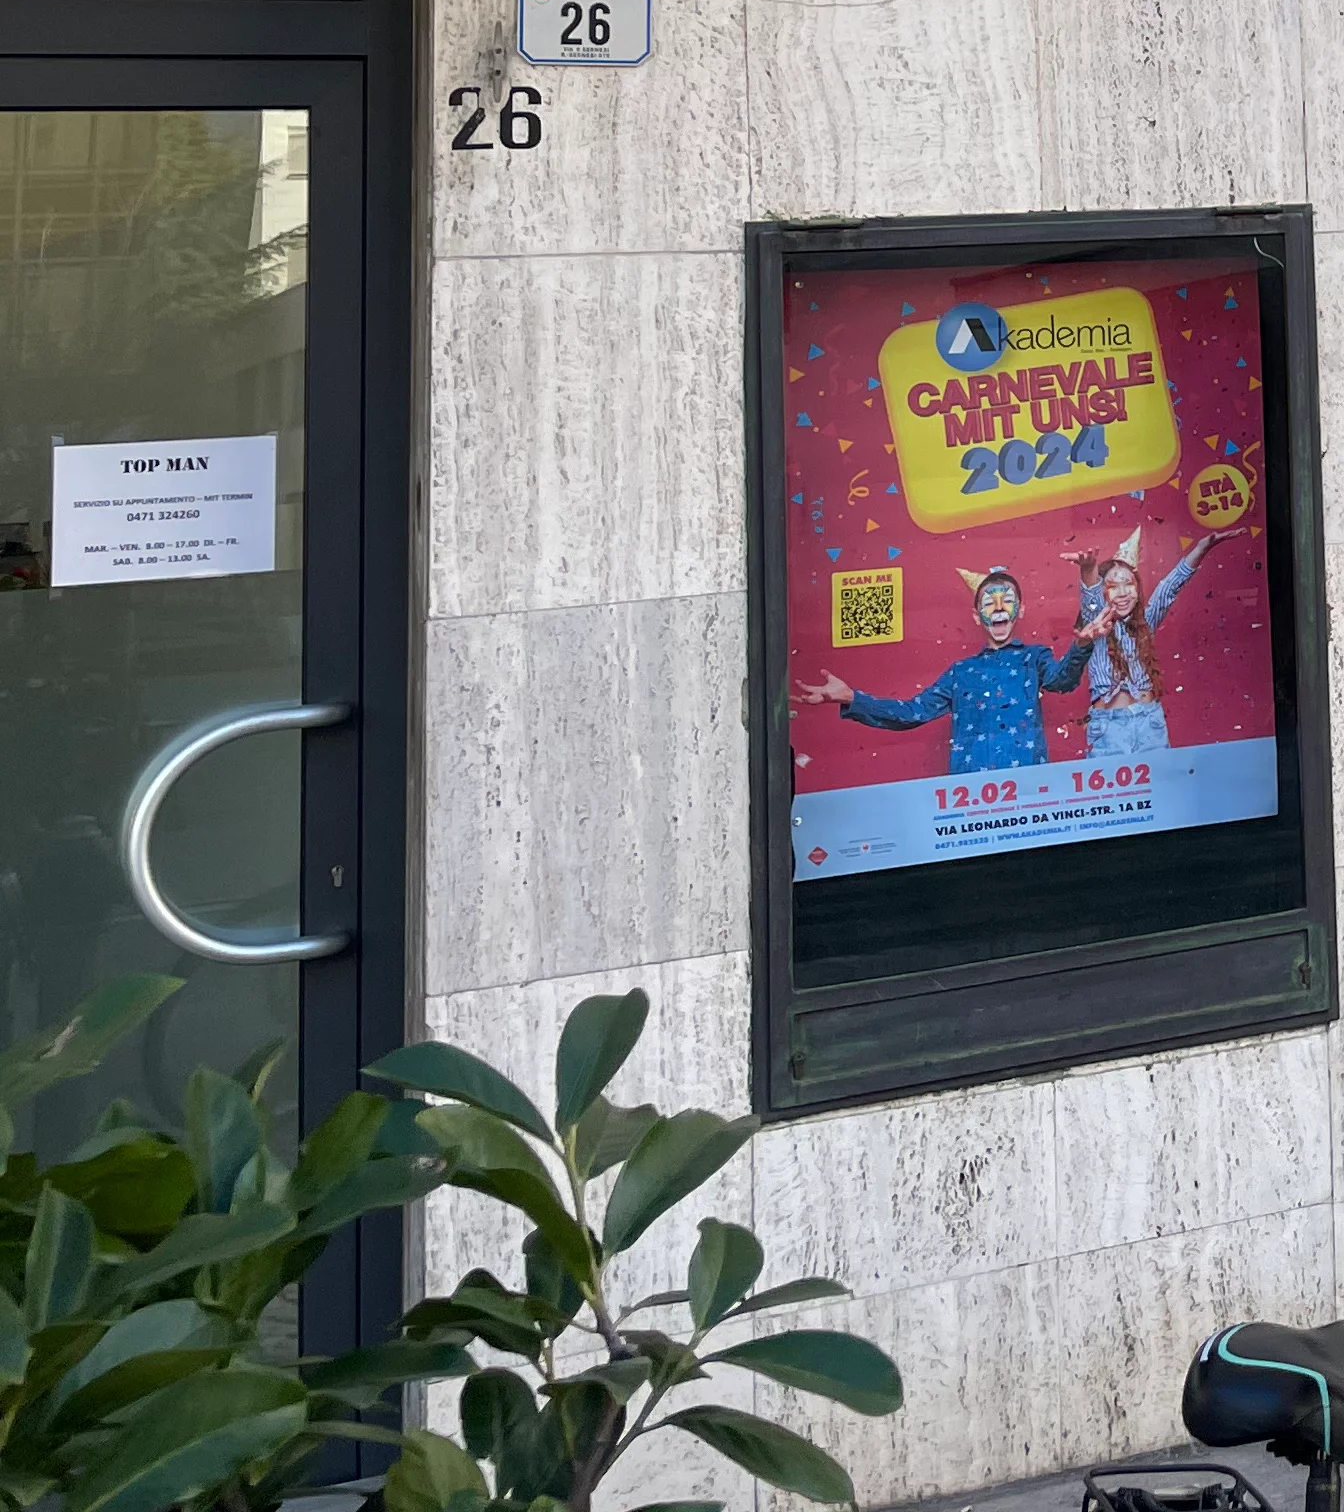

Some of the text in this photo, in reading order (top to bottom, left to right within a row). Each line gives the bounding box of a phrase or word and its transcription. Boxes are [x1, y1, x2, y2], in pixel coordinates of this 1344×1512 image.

[560, 2, 610, 45] 26
[448, 86, 542, 150] 26
[907, 352, 1155, 418] CARNEVALE
[944, 390, 1129, 448] MIT UNS!
[120, 457, 210, 474] TOP MAN
[960, 424, 1110, 495] 2024
[127, 509, 200, 522] 0471 324260
[842, 574, 893, 586] SCAN ME
[935, 780, 1018, 810] 12.02
[1071, 763, 1151, 793] 16.02
[935, 825, 957, 836] VIA
[961, 816, 1028, 833] LEONARDO
[1032, 812, 1049, 824] DA
[1052, 806, 1115, 821] VINCI-STR.
[1119, 802, 1134, 812] 1A
[1137, 800, 1152, 810] BZ
